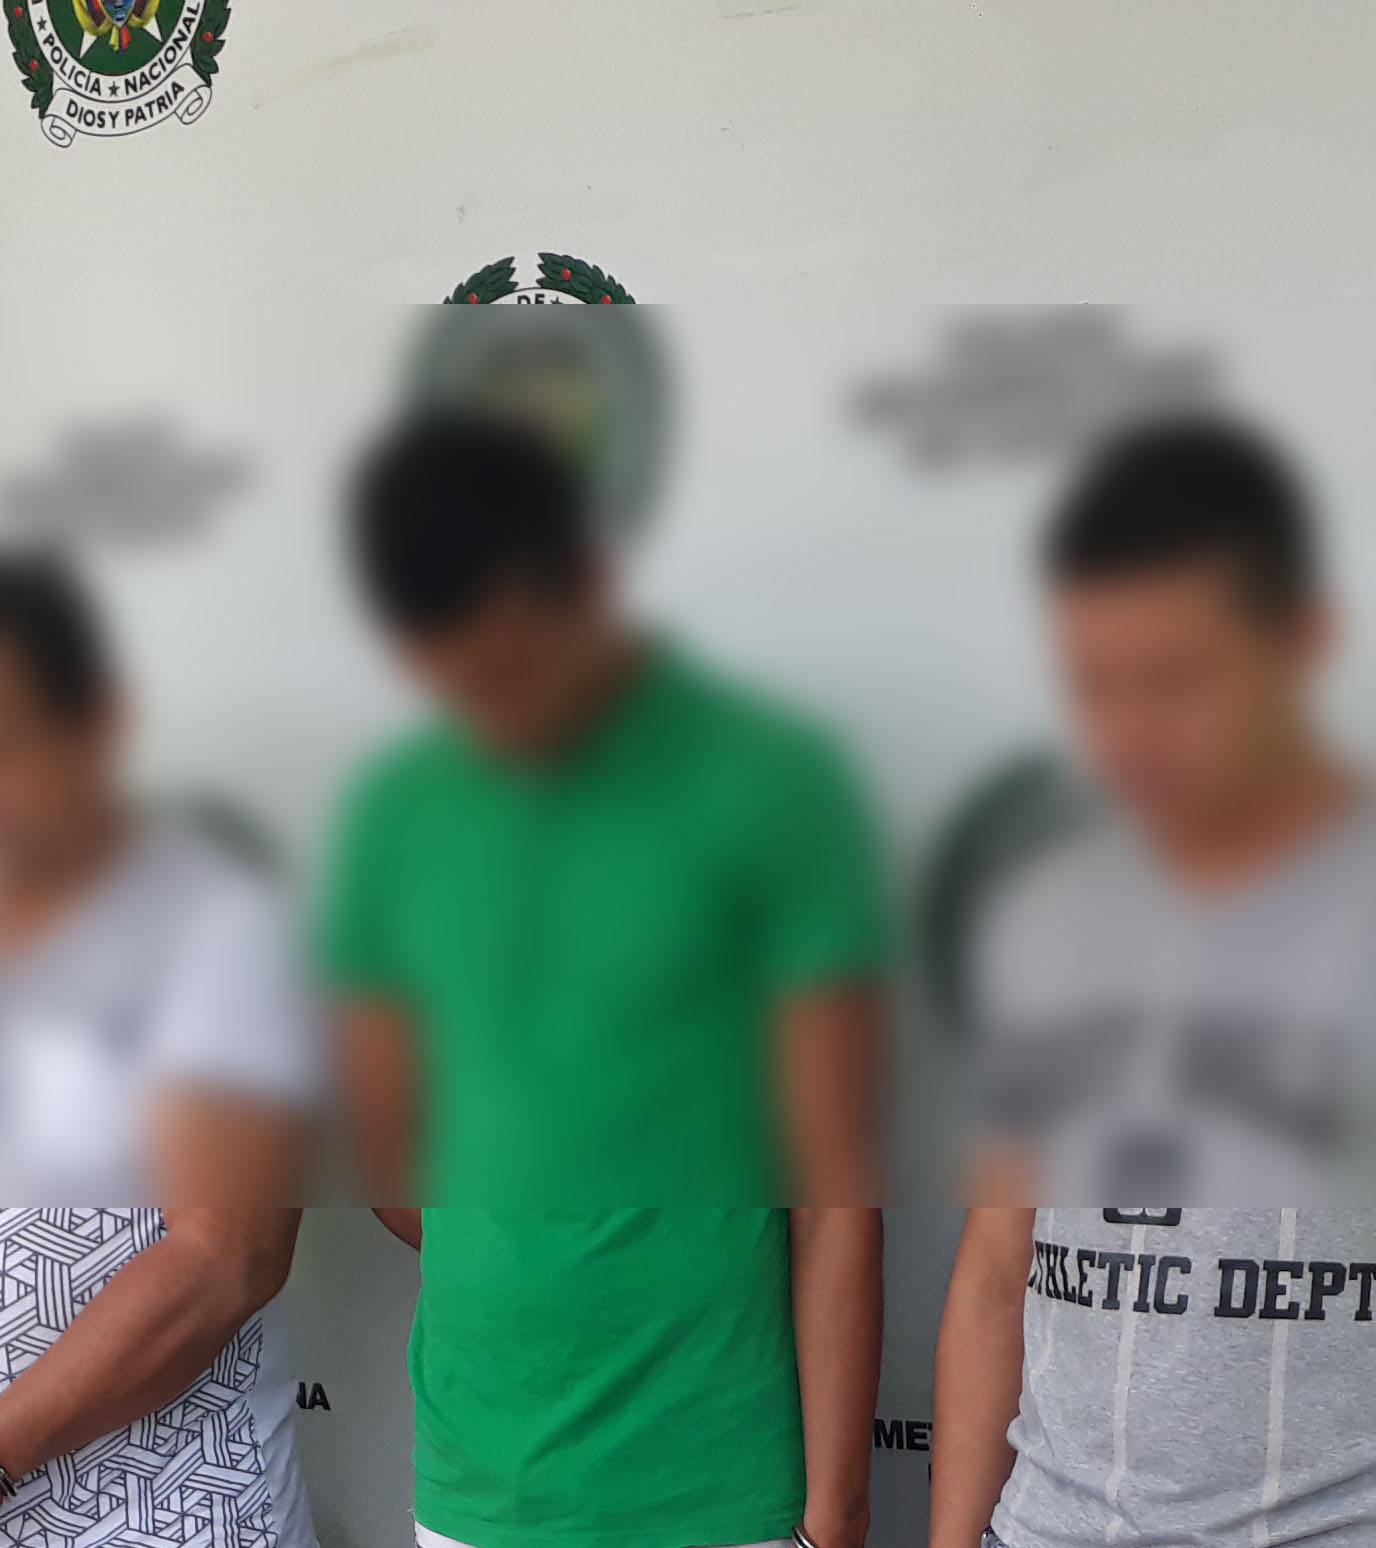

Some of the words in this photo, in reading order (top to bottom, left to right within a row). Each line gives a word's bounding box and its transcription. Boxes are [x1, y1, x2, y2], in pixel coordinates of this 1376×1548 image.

[124, 1, 201, 96] NACIONAL
[125, 81, 185, 127] PATRIA
[873, 1419, 933, 1451] ME
